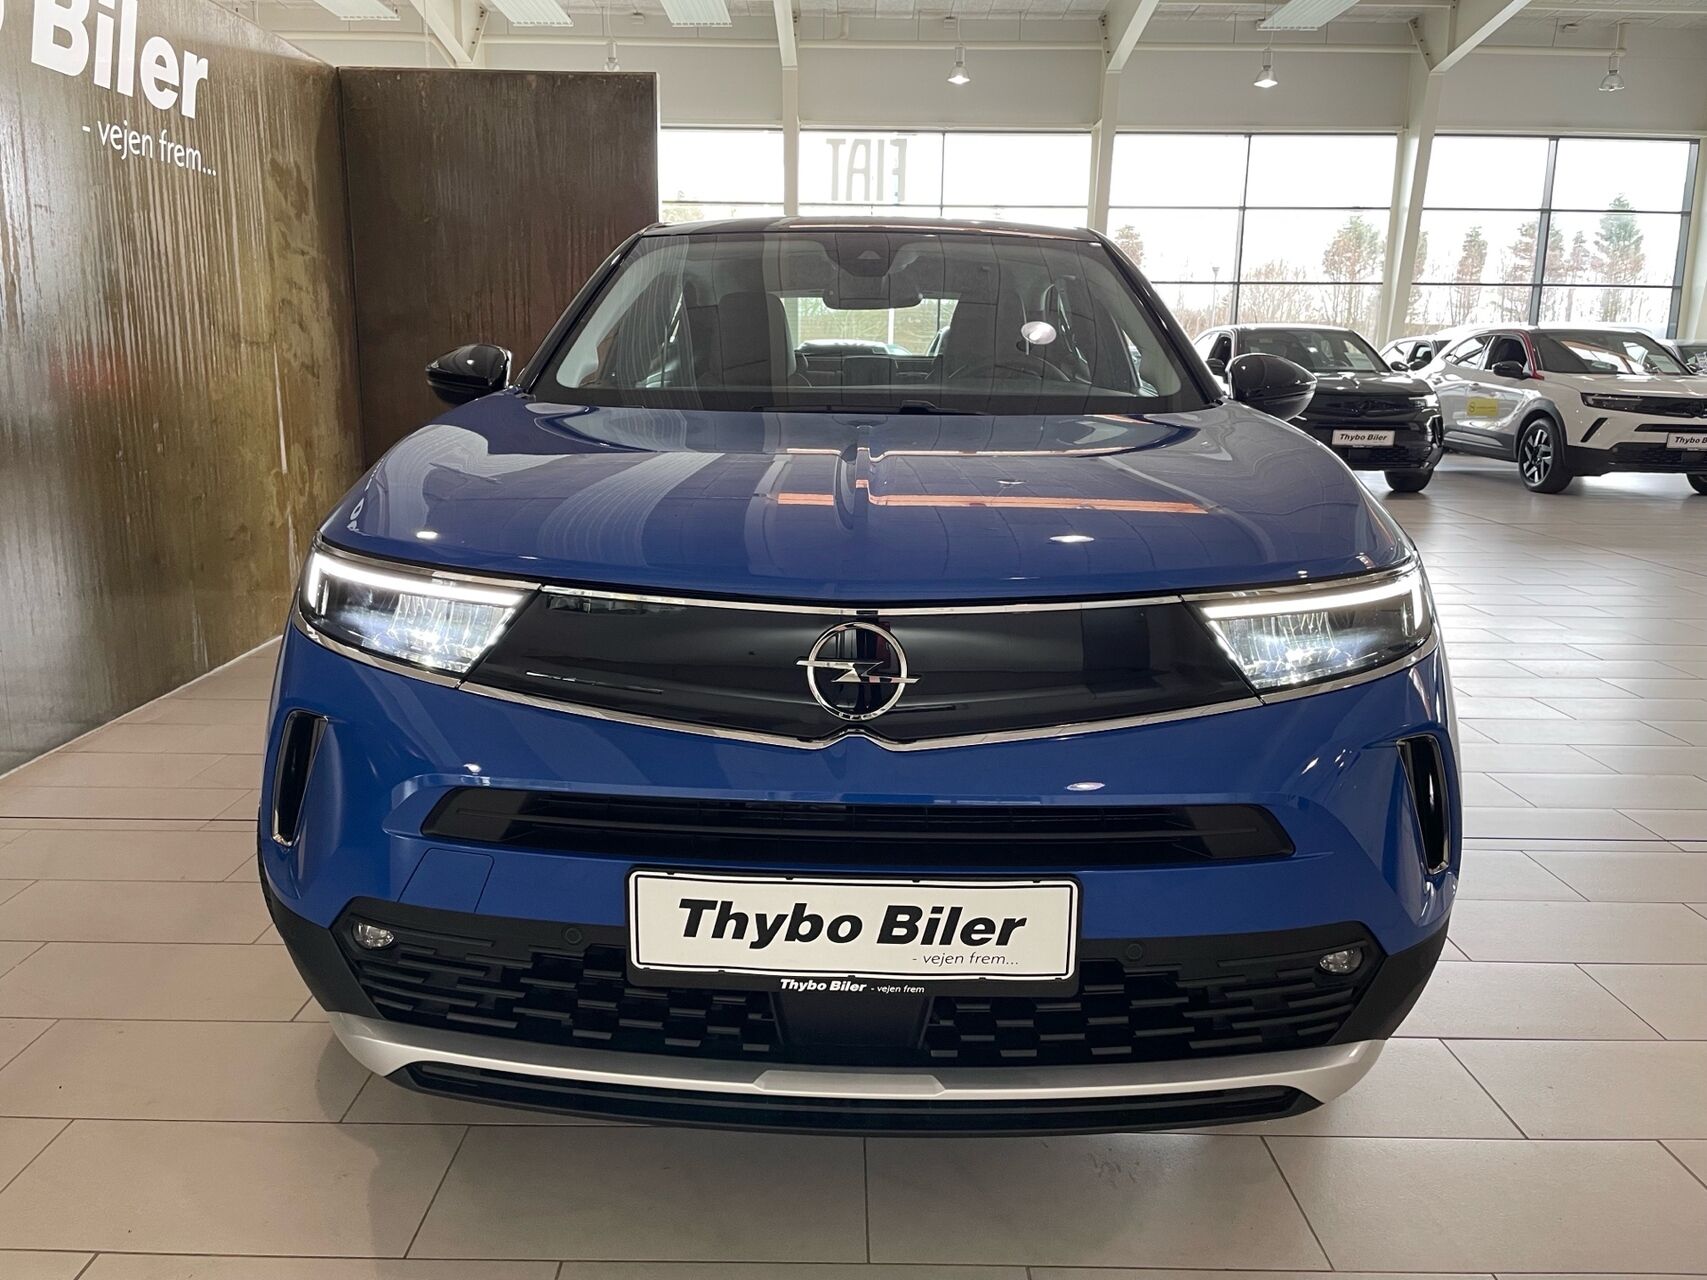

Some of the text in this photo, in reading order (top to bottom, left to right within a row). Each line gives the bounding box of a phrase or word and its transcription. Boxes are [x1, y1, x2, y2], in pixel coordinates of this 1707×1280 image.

[31, 0, 209, 119] Biler
[97, 119, 153, 160] vejen
[158, 129, 217, 177] frem...
[1340, 433, 1365, 441] Thybo
[1675, 436, 1700, 444] Thybo
[679, 898, 1027, 949] Thybo Biler
[923, 953, 964, 967] vejen
[969, 951, 1019, 965] frem...
[780, 979, 827, 992] Thybo
[829, 981, 867, 992] Biler
[877, 985, 901, 994] vejen
[903, 985, 925, 993] frem
